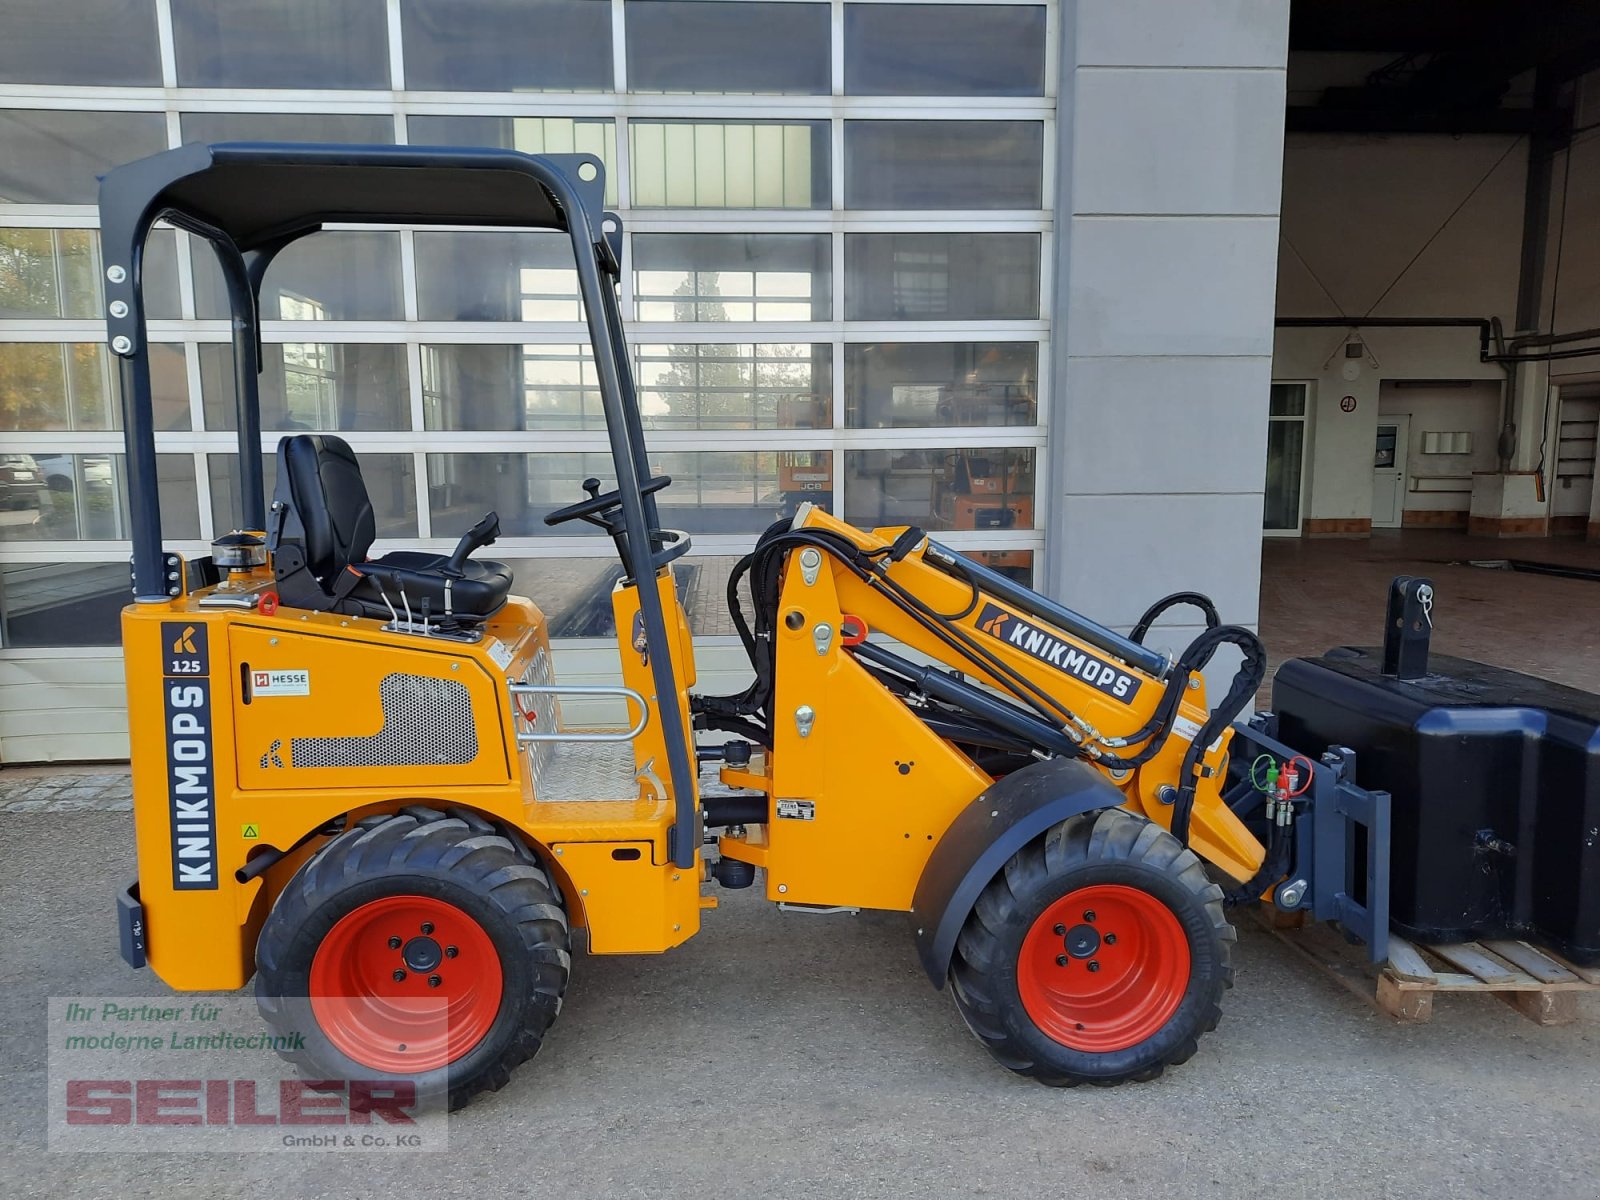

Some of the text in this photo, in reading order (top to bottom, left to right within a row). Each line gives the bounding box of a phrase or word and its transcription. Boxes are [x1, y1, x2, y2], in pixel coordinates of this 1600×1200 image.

[172, 660, 201, 673] 125
[272, 675, 306, 683] HESSE
[1009, 622, 1132, 697] KNIKMOPS
[170, 686, 212, 883] KNIKMOPS
